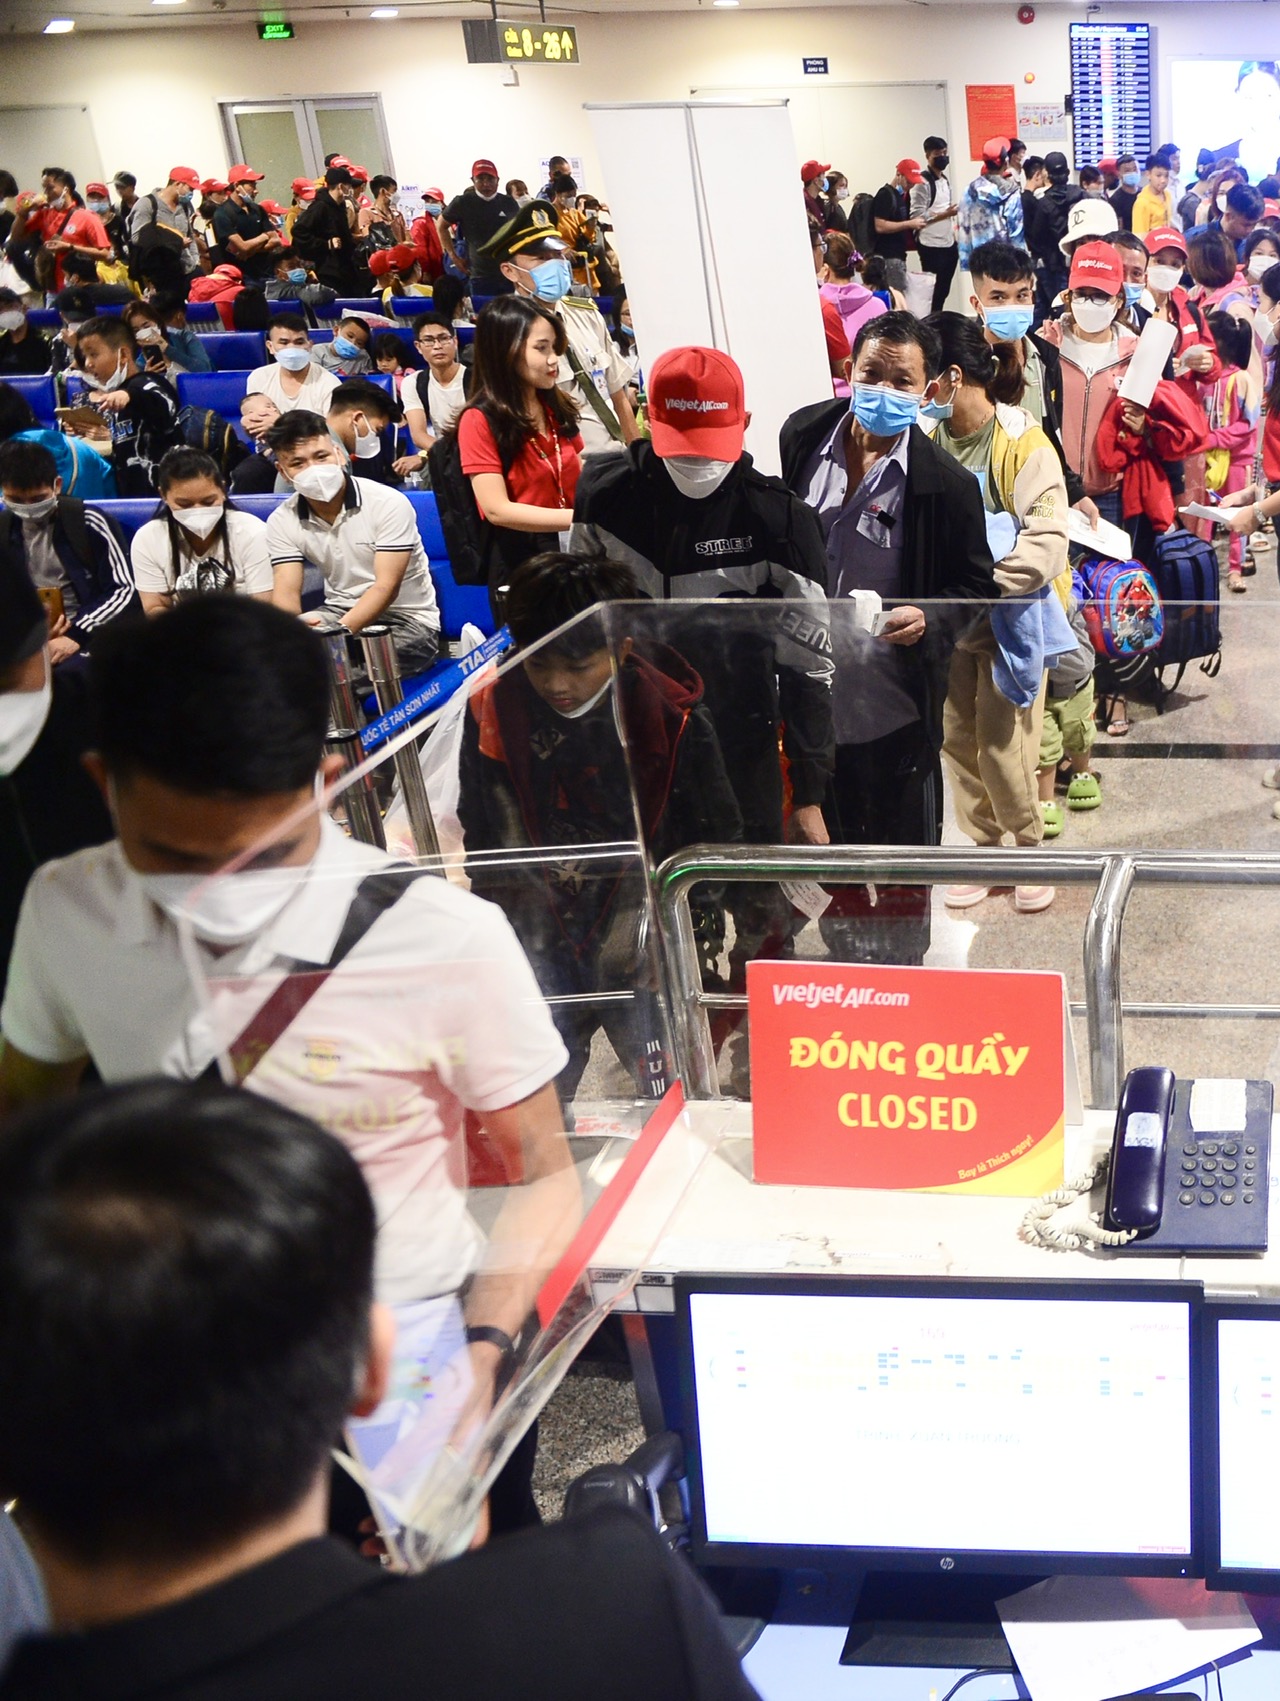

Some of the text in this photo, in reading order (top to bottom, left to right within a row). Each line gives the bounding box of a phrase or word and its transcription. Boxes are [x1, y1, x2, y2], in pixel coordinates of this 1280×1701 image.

[457, 650, 486, 676] TIA
[360, 725, 380, 746] UỐC
[789, 1030, 1030, 1081] ĐÓNG QUẦY
[837, 1092, 978, 1132] CLOSED
[957, 1134, 1034, 1180] Bay là Thích ngay!
